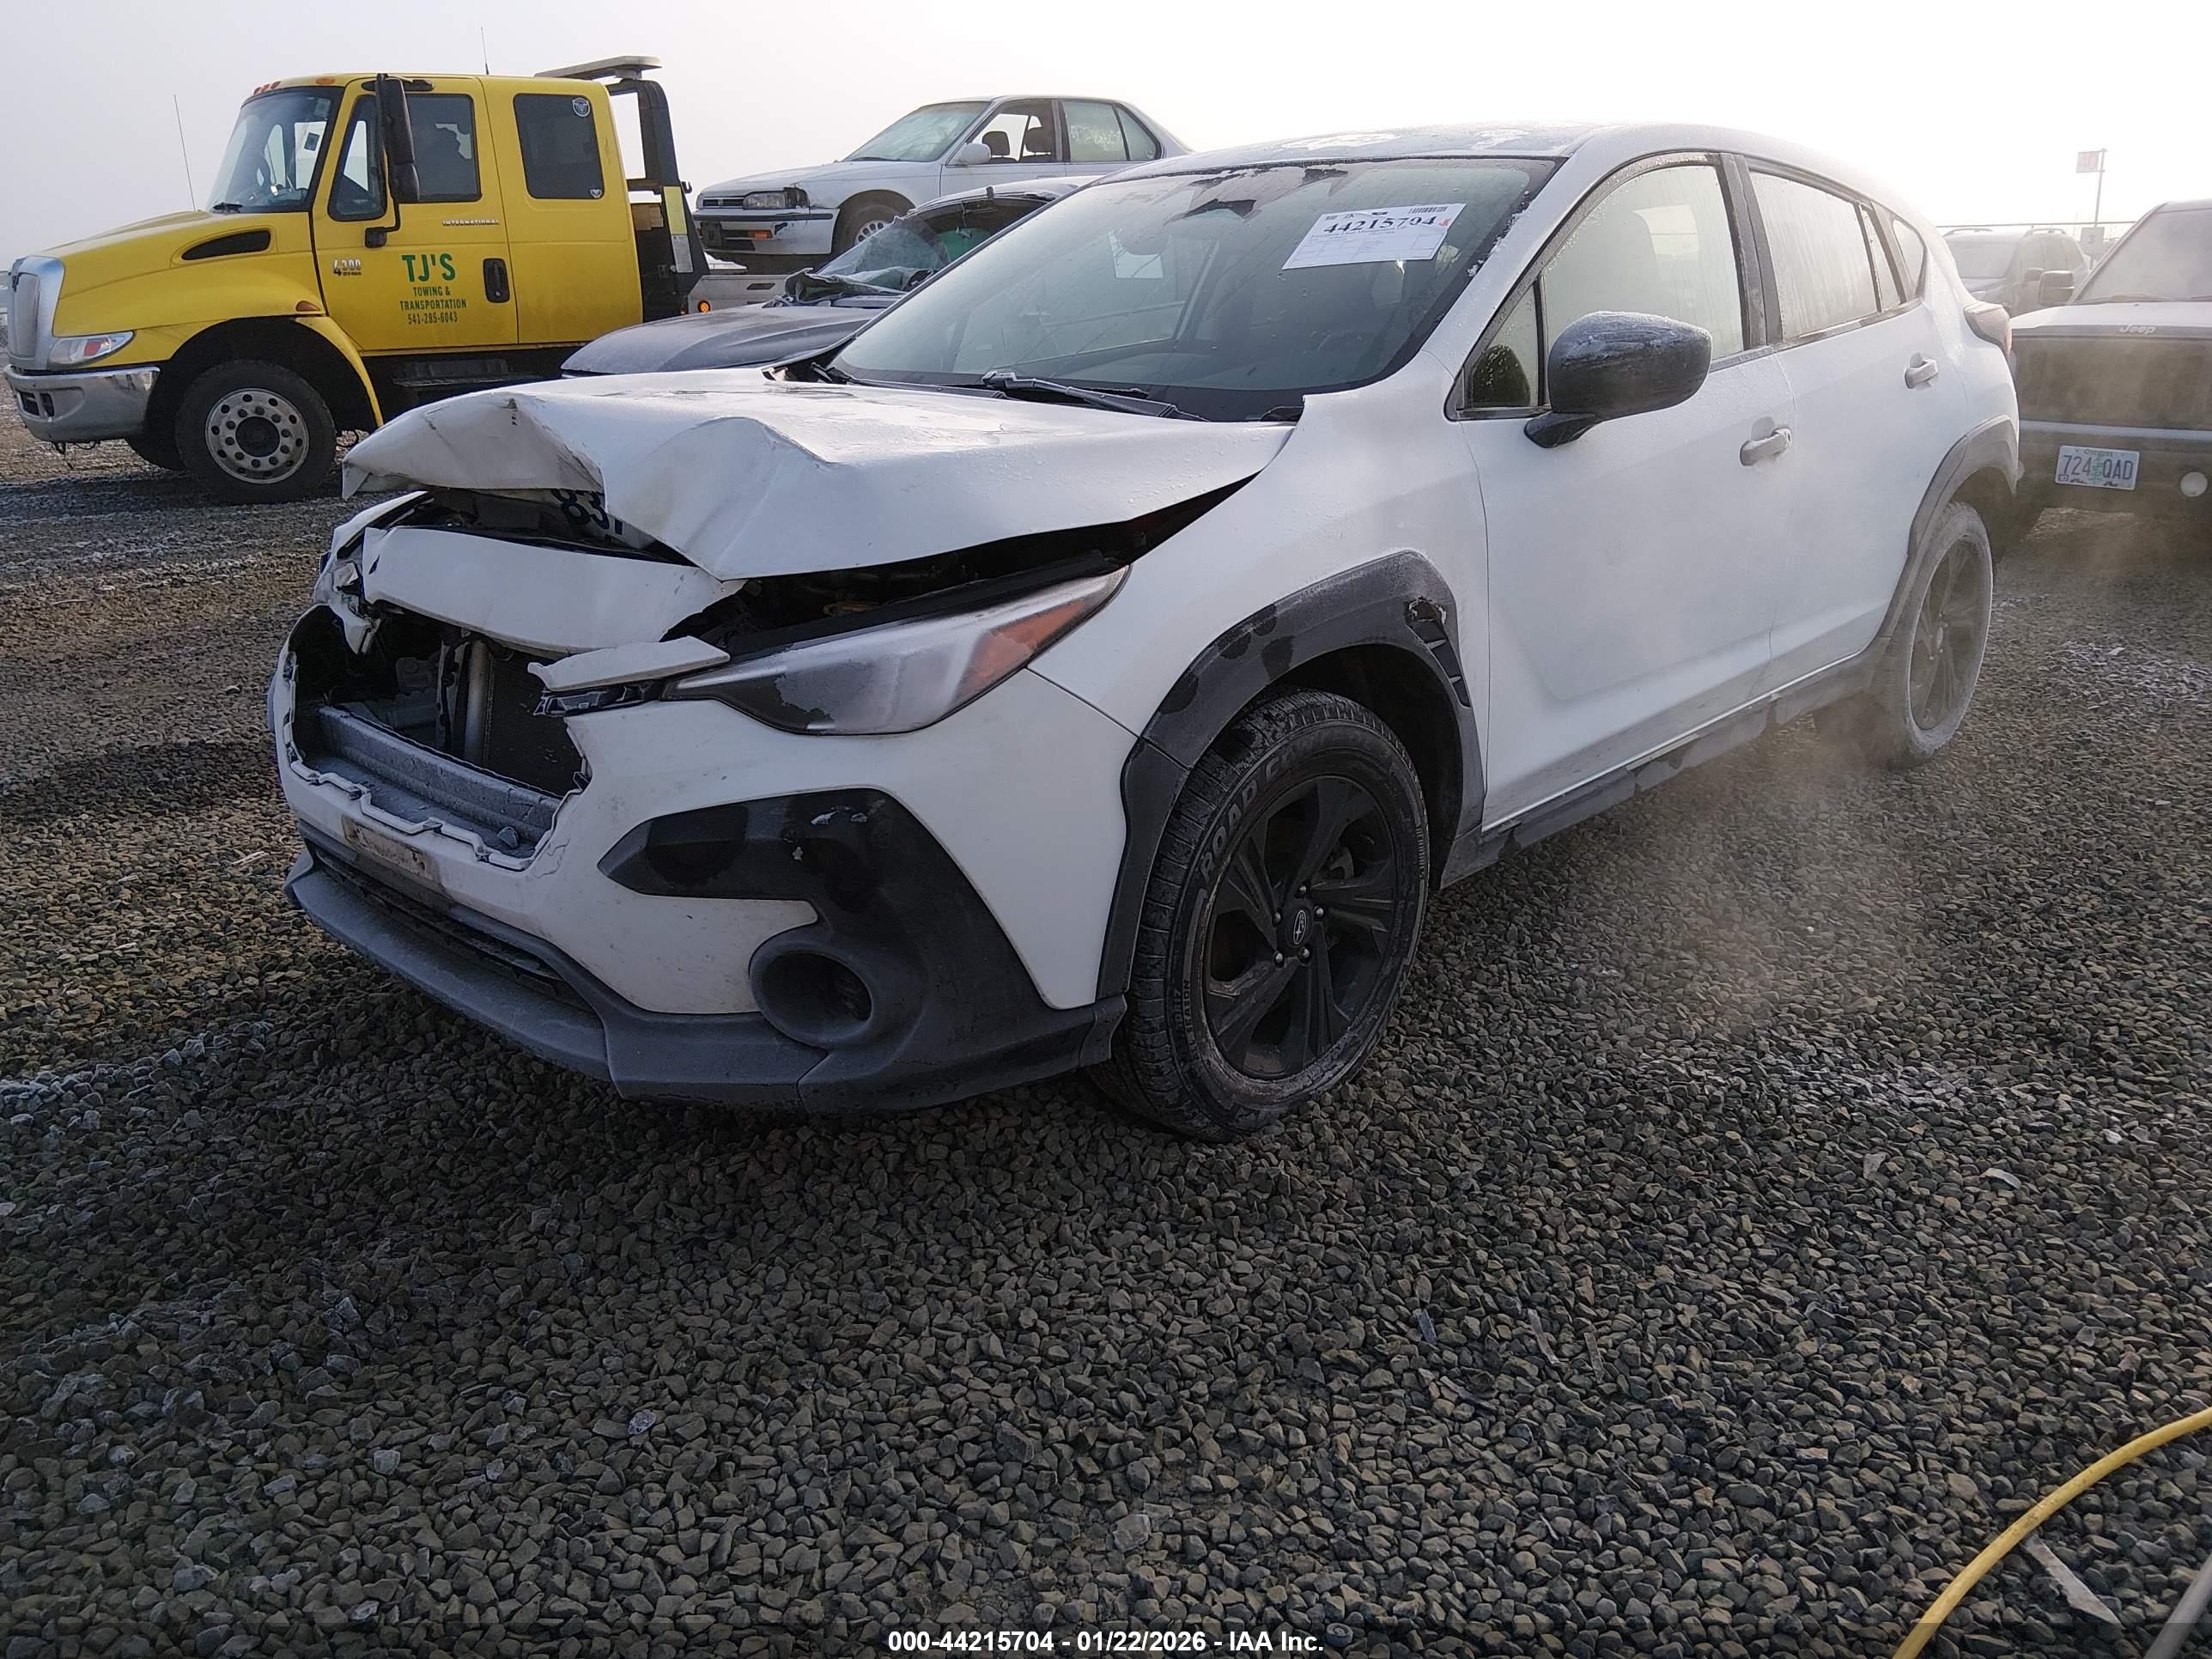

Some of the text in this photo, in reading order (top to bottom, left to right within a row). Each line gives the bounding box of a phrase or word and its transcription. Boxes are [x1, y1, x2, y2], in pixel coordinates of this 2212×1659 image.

[401, 253, 456, 283] TJ'S
[413, 286, 451, 297] TOWING &
[399, 298, 467, 312] TRANSPORTATION
[2119, 324, 2156, 335] Jeep
[2061, 454, 2134, 480] 724 QAD
[1200, 780, 1258, 880] ROAD
[1182, 979, 1194, 1034] SEASON
